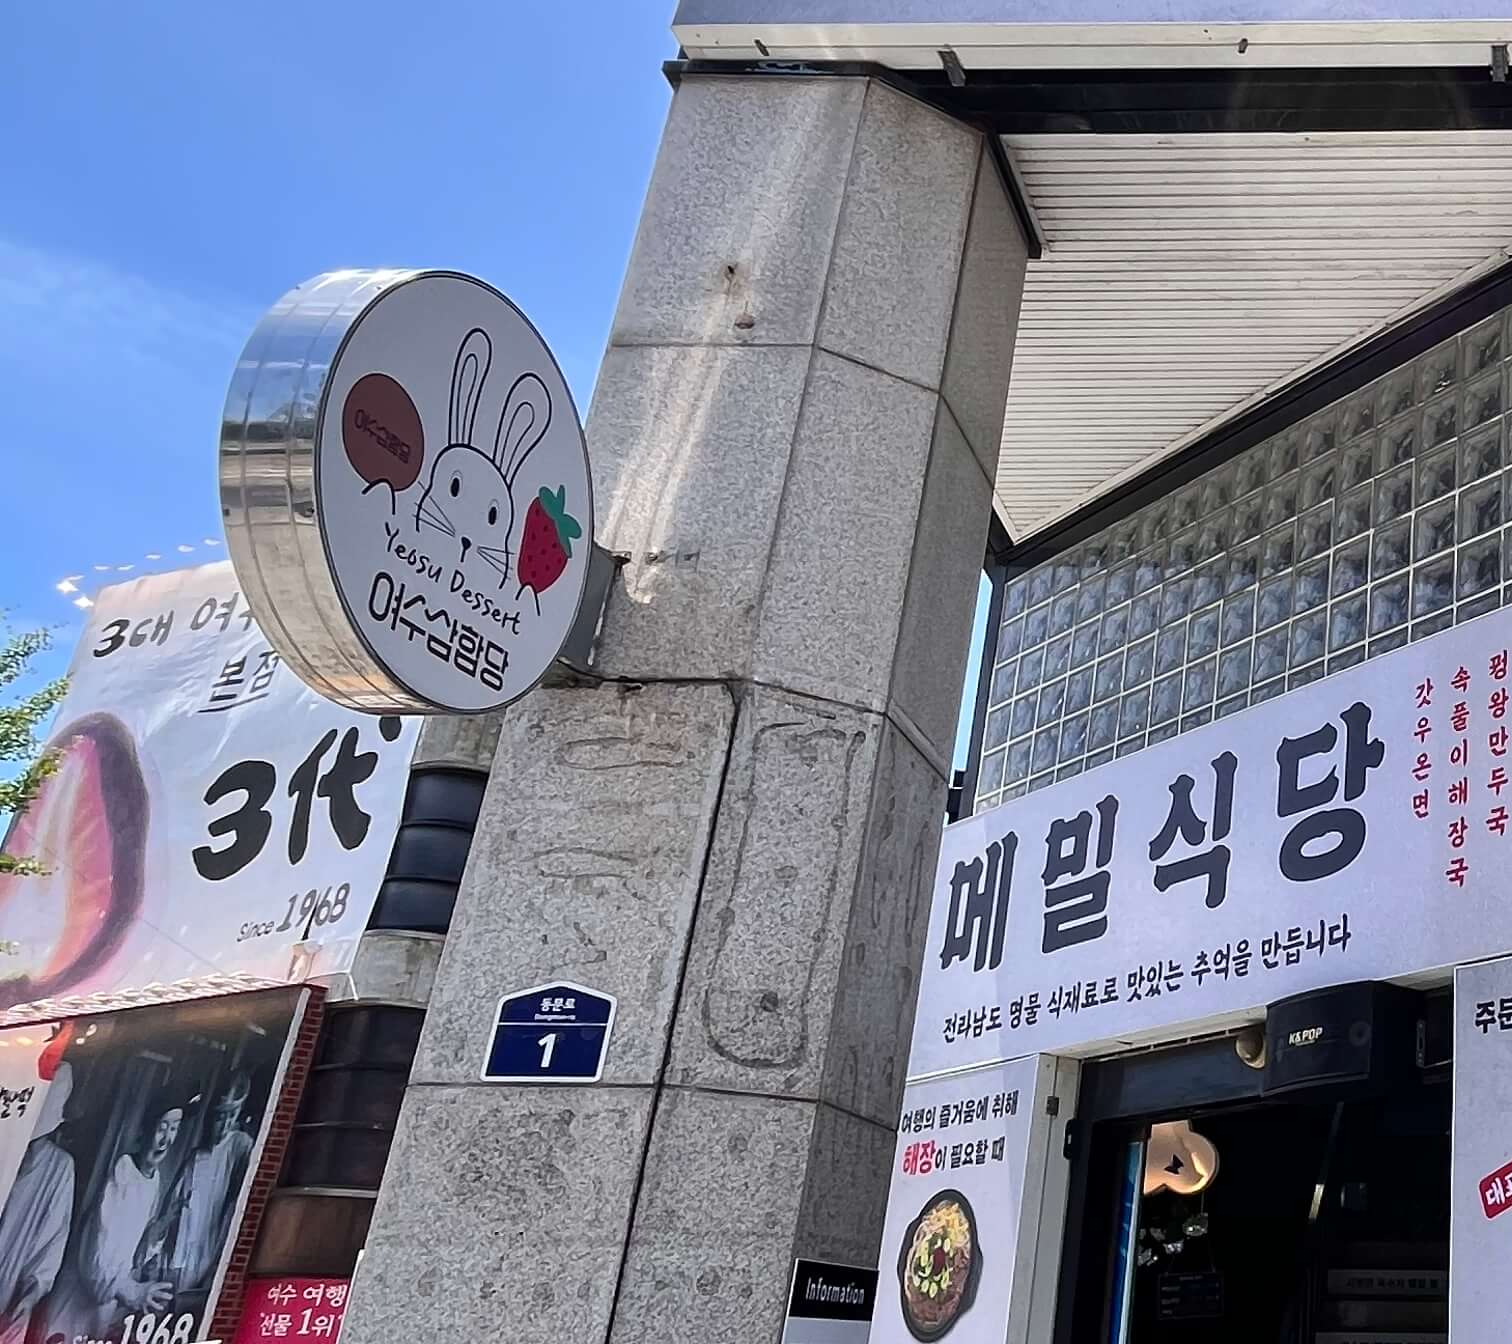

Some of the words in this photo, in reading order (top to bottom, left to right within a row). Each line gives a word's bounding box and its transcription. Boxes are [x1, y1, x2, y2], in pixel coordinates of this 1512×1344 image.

[385, 522, 442, 583] Yeosu
[450, 569, 521, 635] Dessert
[93, 610, 175, 658] 3대
[209, 651, 281, 703] 본점
[1412, 678, 1434, 819] 갓우온면
[1445, 666, 1471, 887] 속풀이해장국
[939, 700, 1386, 973] 메밀식당
[237, 919, 275, 943] Since
[275, 882, 351, 941] 1968
[943, 1006, 1003, 1043] 전라남도
[1010, 993, 1041, 1029] 명물
[1047, 977, 1119, 1018] 식재료로
[1127, 960, 1184, 1002] 맛있는
[1191, 939, 1252, 986] 추억을
[1261, 914, 1352, 968] 만듭니다
[538, 1033, 556, 1067] 1
[901, 1106, 936, 1135] 여행의
[991, 1089, 1020, 1117] 취해
[902, 1139, 946, 1176] 해장이
[950, 1142, 988, 1170] 필요할
[990, 1136, 1006, 1162] 때
[267, 1283, 297, 1306] 여수
[303, 1284, 347, 1307] 여행
[806, 1277, 864, 1305] Information
